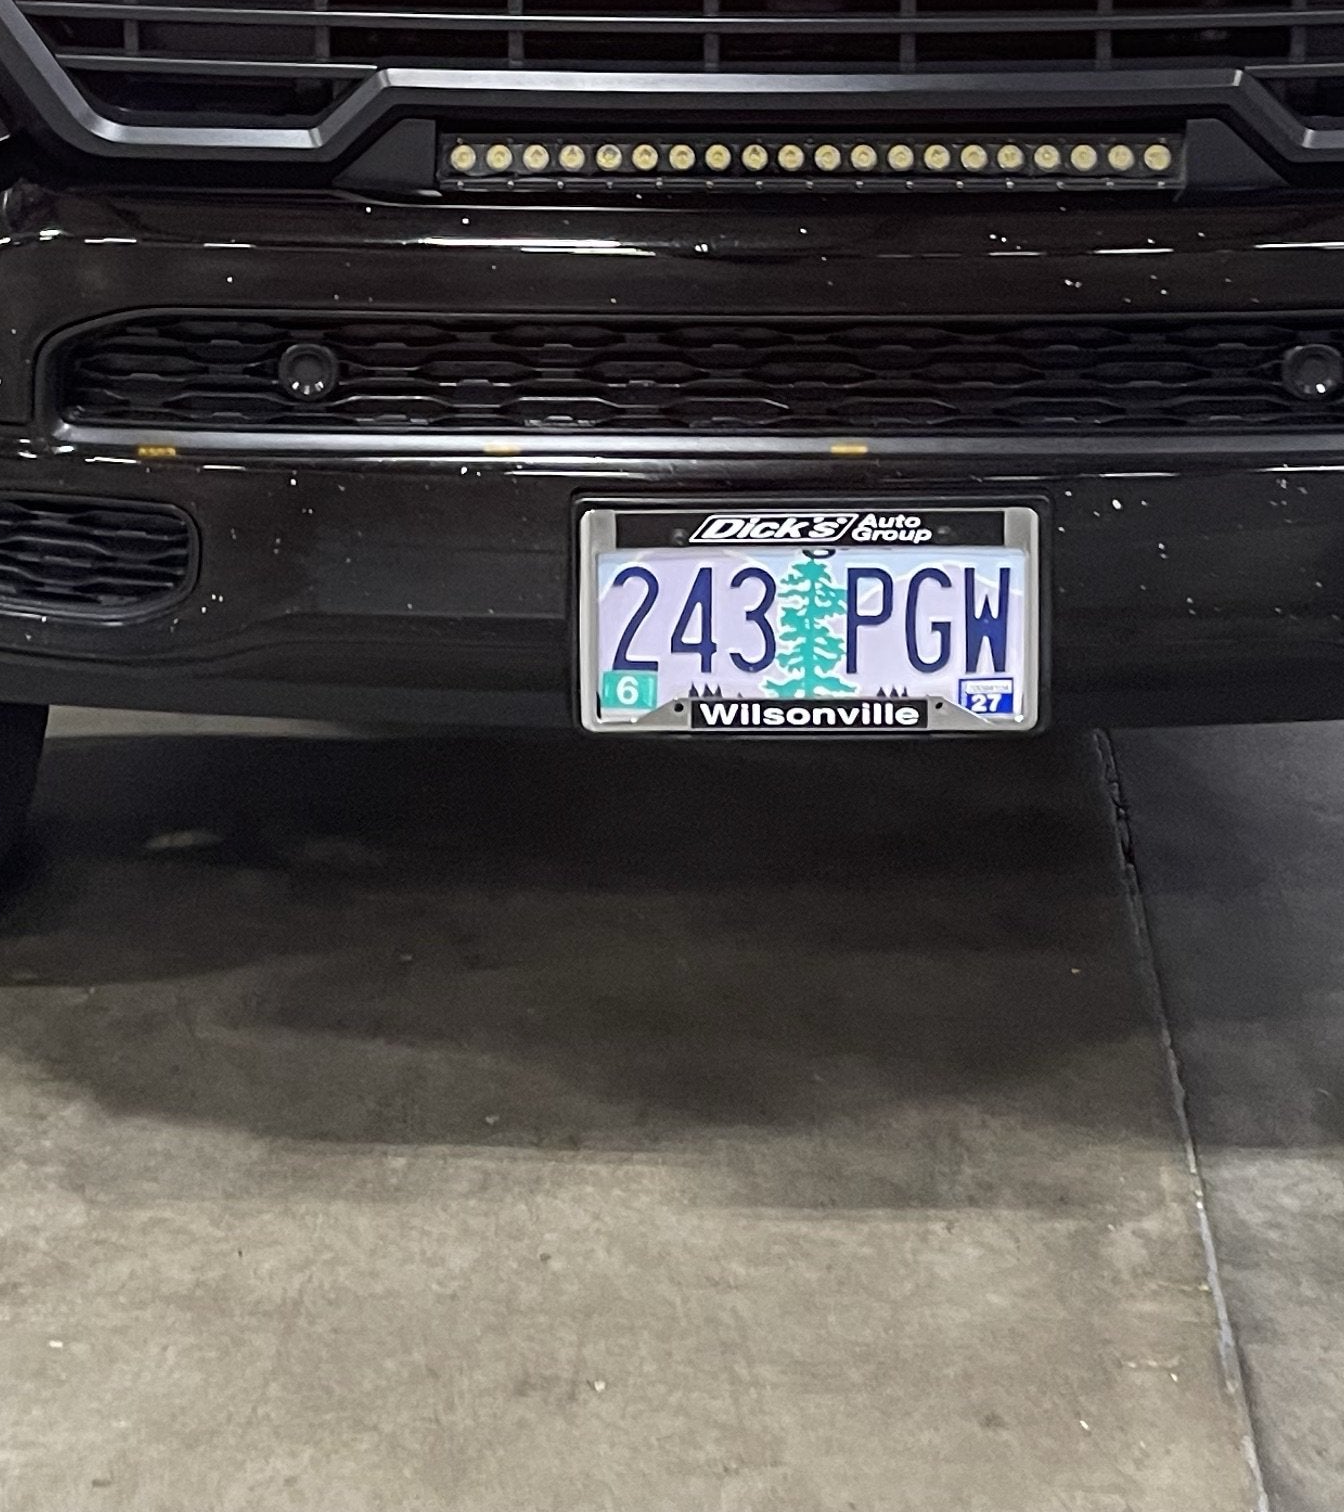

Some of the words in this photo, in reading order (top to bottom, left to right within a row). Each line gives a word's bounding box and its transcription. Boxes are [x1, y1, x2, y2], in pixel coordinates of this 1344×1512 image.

[858, 513, 921, 529] Auto
[851, 527, 932, 543] Group
[612, 566, 778, 673] 243
[845, 566, 1012, 674] PGW
[616, 677, 639, 702] 6
[971, 693, 1002, 713] 27
[699, 702, 919, 727] Wilsonville
